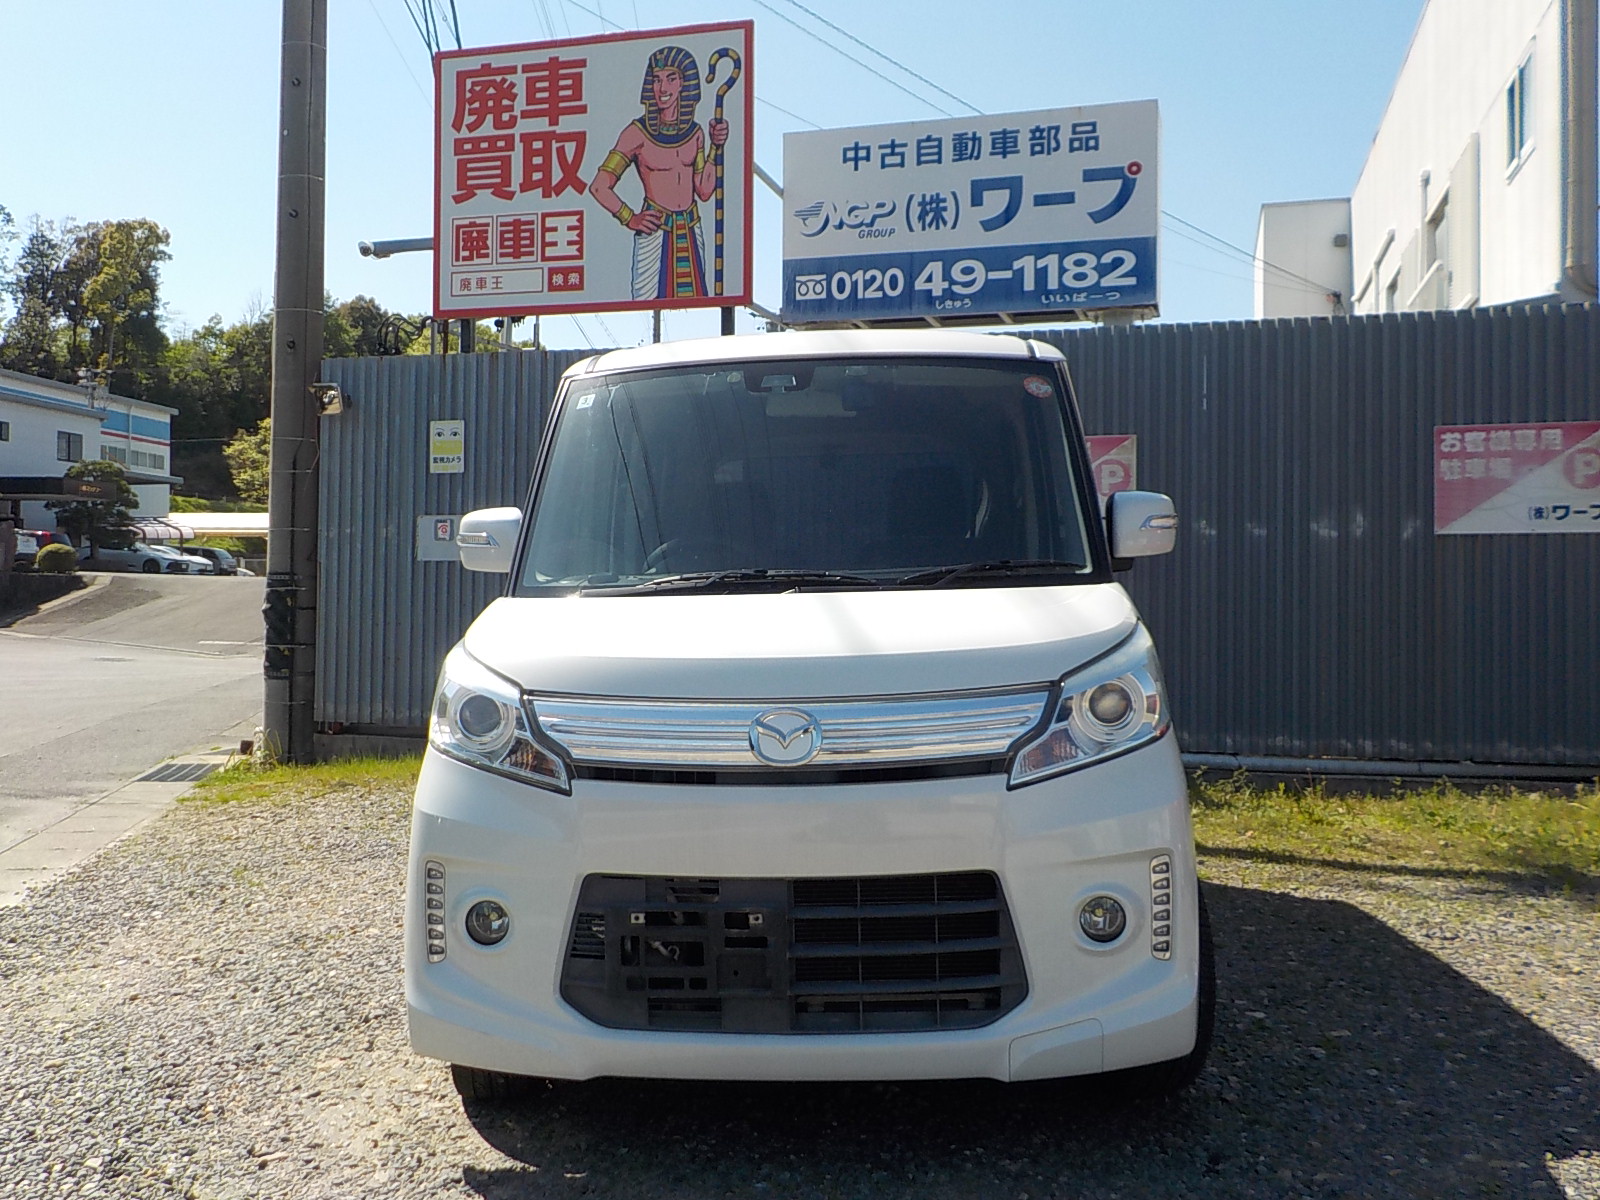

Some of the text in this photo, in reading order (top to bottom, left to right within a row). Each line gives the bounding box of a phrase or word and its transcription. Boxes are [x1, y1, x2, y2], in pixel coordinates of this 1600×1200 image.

[451, 55, 588, 134] 廃車
[842, 120, 1101, 172] 中古自動車部品
[450, 130, 588, 205] 買取
[453, 210, 584, 264] 廃車王
[858, 227, 896, 239] GROUP
[458, 275, 504, 292] 廃車王
[551, 271, 581, 287] 検索
[830, 267, 905, 301] 0120
[935, 298, 973, 310] しきゅう
[1101, 464, 1124, 493] P
